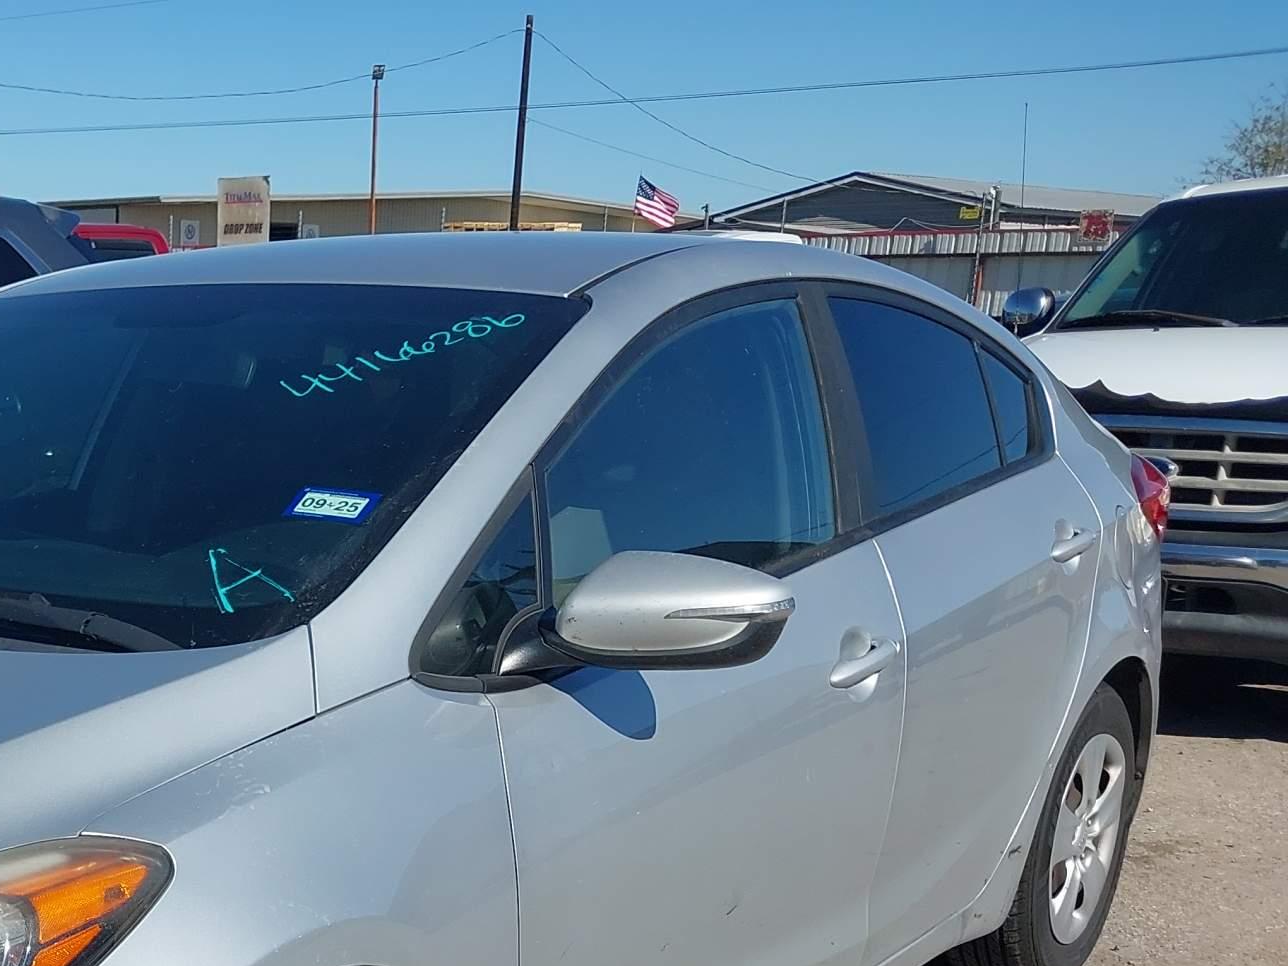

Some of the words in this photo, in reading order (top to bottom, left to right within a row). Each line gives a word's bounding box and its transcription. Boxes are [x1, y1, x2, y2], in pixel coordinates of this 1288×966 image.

[224, 223, 244, 235] DROP
[244, 222, 264, 234] ZONE
[278, 312, 526, 398] 44166286
[208, 548, 296, 613] A
